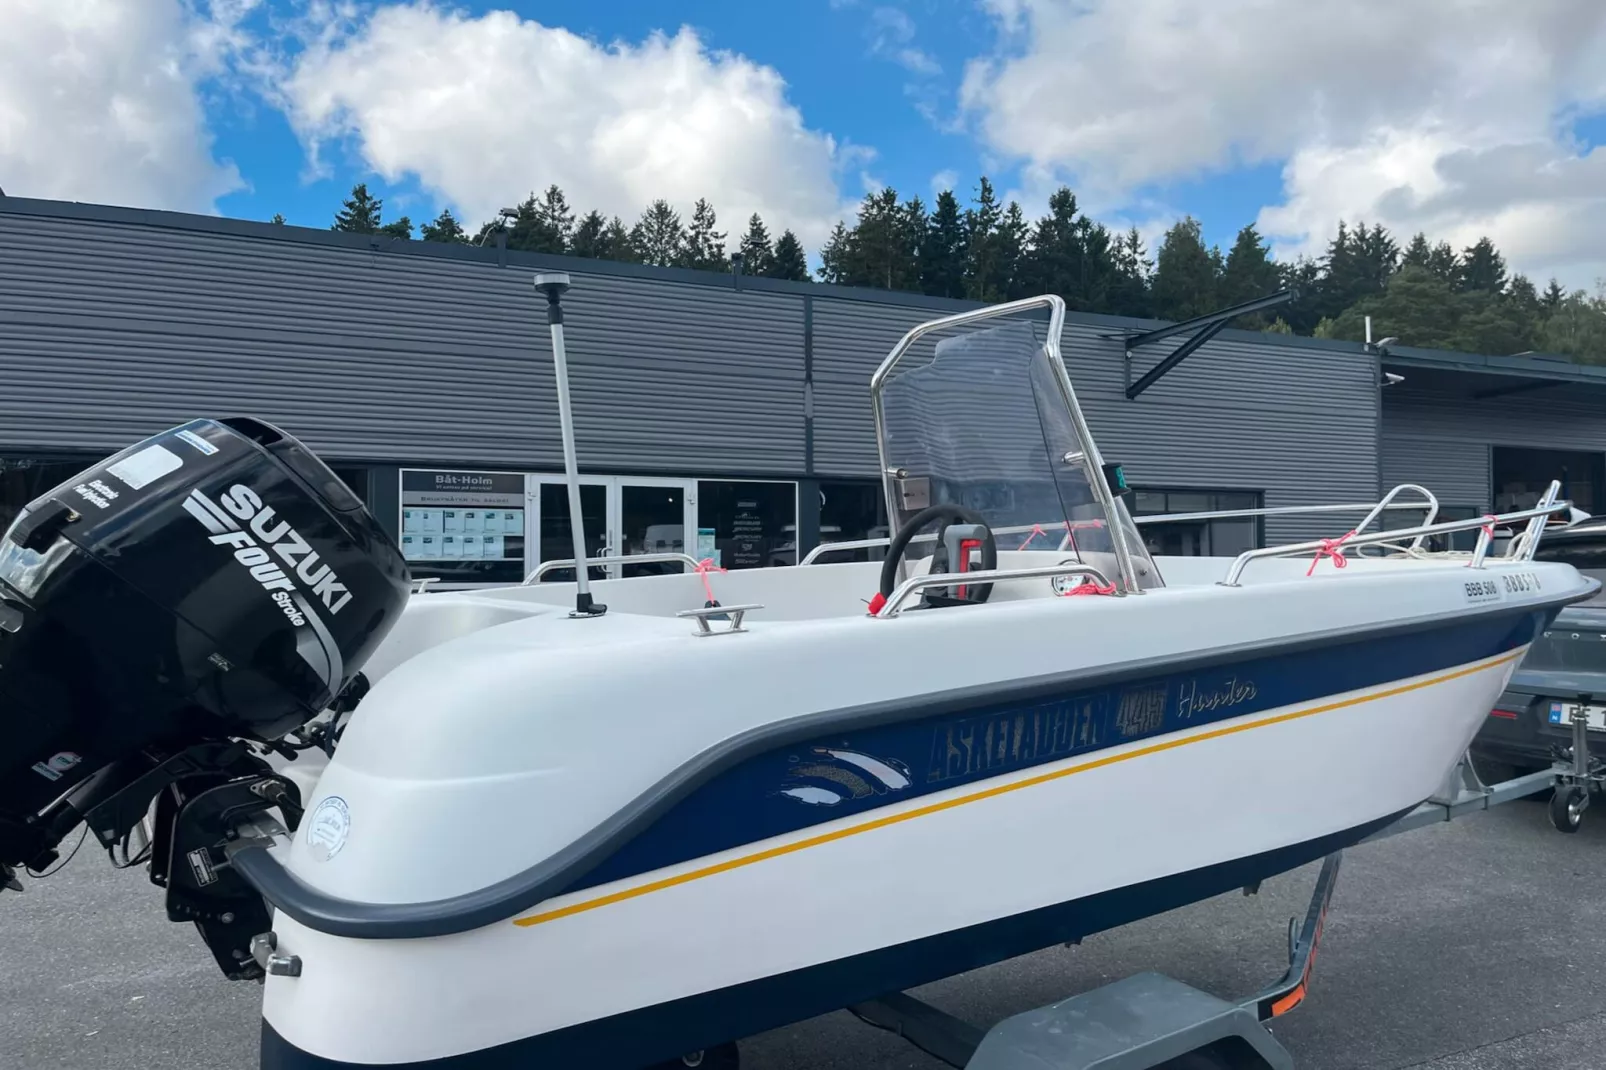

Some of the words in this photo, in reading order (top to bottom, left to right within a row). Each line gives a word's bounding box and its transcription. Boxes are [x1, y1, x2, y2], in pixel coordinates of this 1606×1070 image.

[435, 474, 493, 485] Båt-Holm
[220, 483, 354, 616] SUZUKI
[271, 591, 306, 627] Stroke
